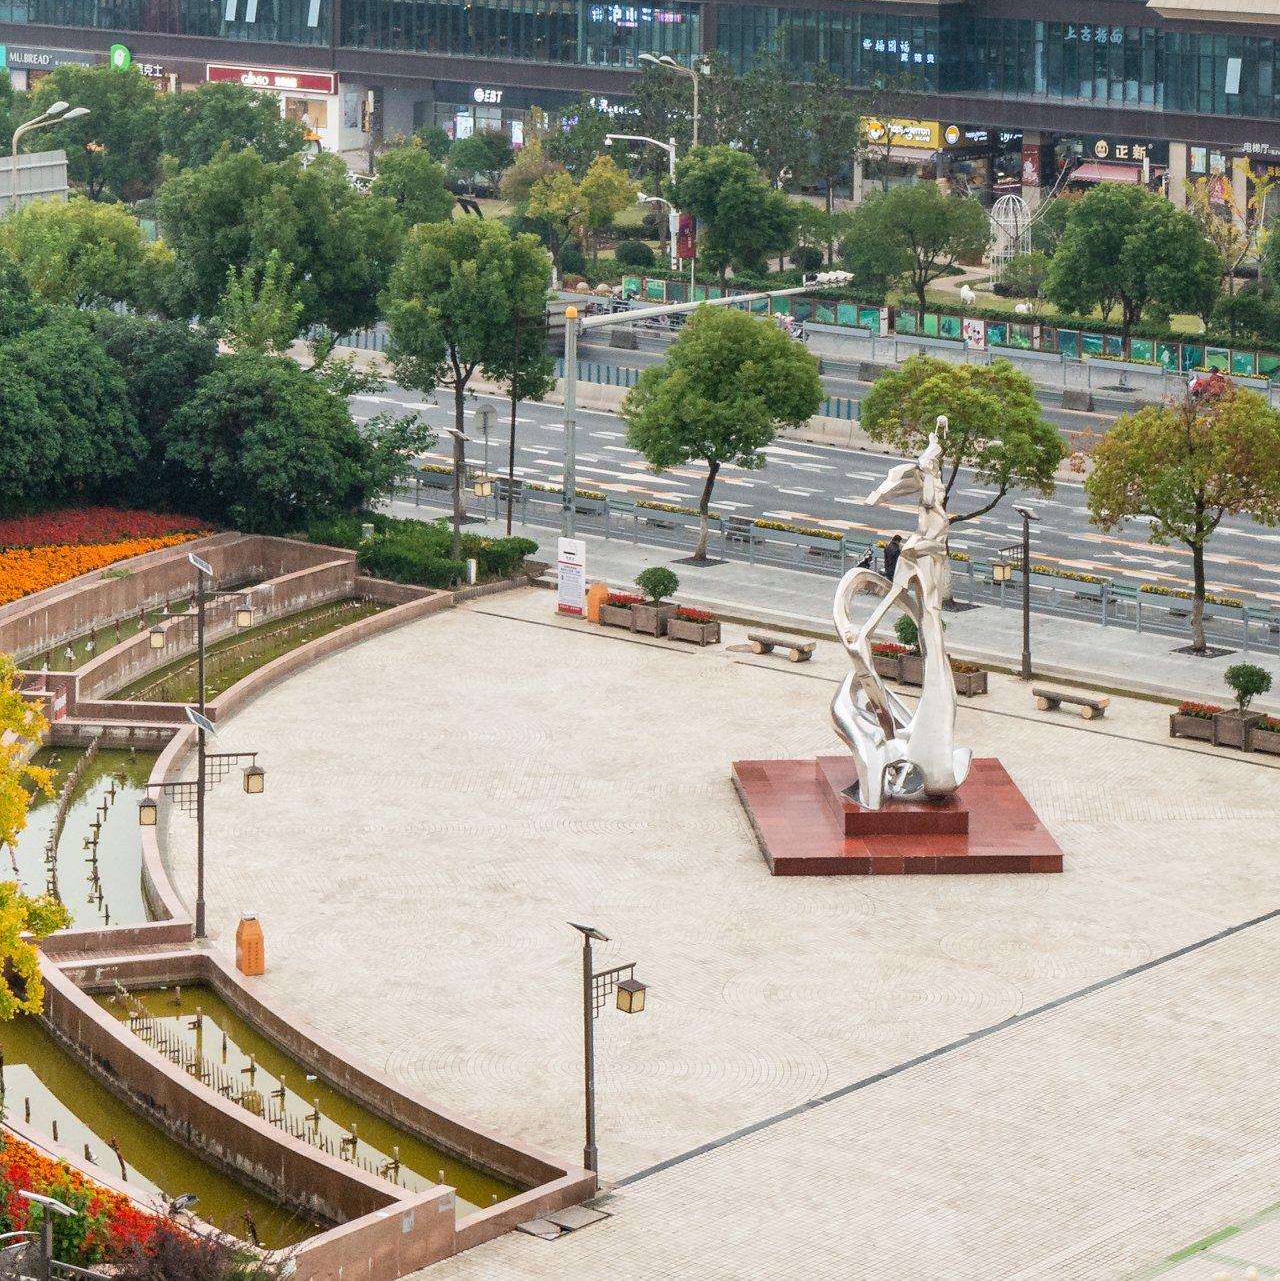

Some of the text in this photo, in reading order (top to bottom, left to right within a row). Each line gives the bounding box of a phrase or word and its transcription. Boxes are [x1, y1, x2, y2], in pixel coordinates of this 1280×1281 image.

[9, 51, 50, 65] MU.BREAD
[484, 89, 503, 104] EBT
[1115, 144, 1147, 160] 正新
